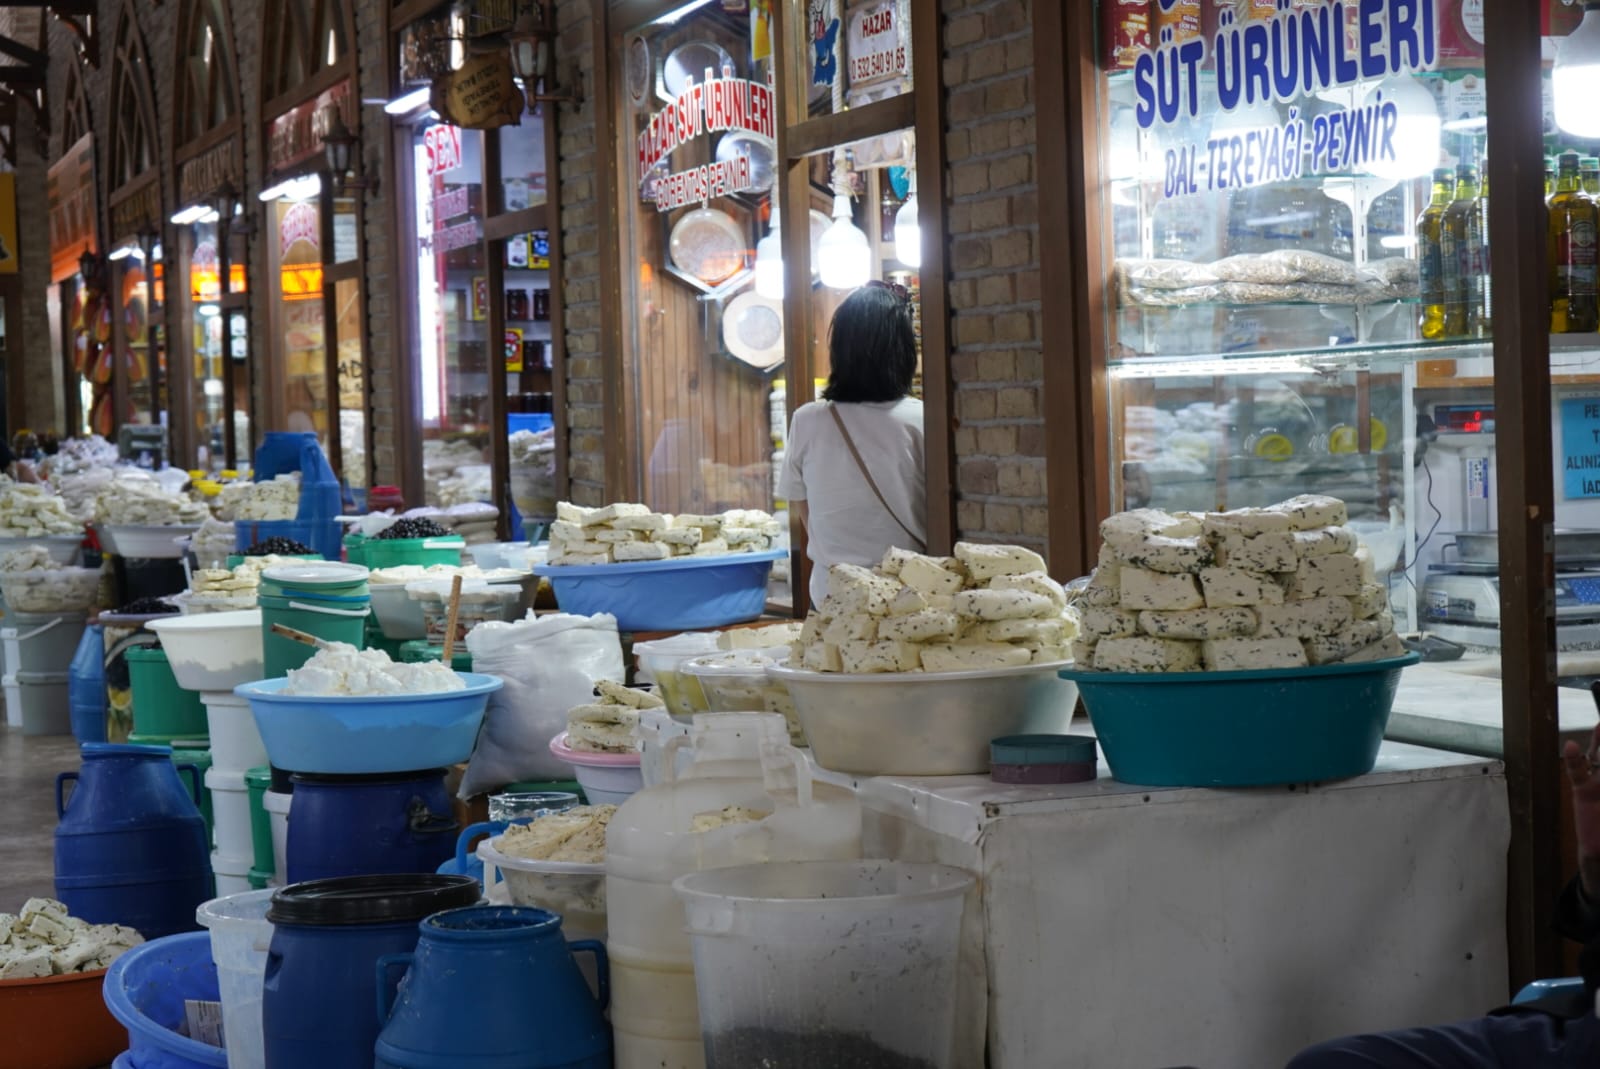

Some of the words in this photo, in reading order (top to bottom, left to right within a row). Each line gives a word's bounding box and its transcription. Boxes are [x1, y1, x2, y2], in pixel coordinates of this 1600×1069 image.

[851, 59, 857, 80] 0
[858, 56, 870, 79] 532
[871, 52, 884, 76] 540
[885, 49, 894, 73] 91
[896, 47, 906, 70] 65
[862, 10, 892, 38] HAZAR
[638, 103, 677, 179] HAZAR
[677, 77, 703, 142] SÜT
[705, 66, 775, 139] ÜRÜNLERİ
[1135, 28, 1204, 129] SÜT
[1164, 89, 1398, 198] BAL-TEREYAĞI-PEYNİR
